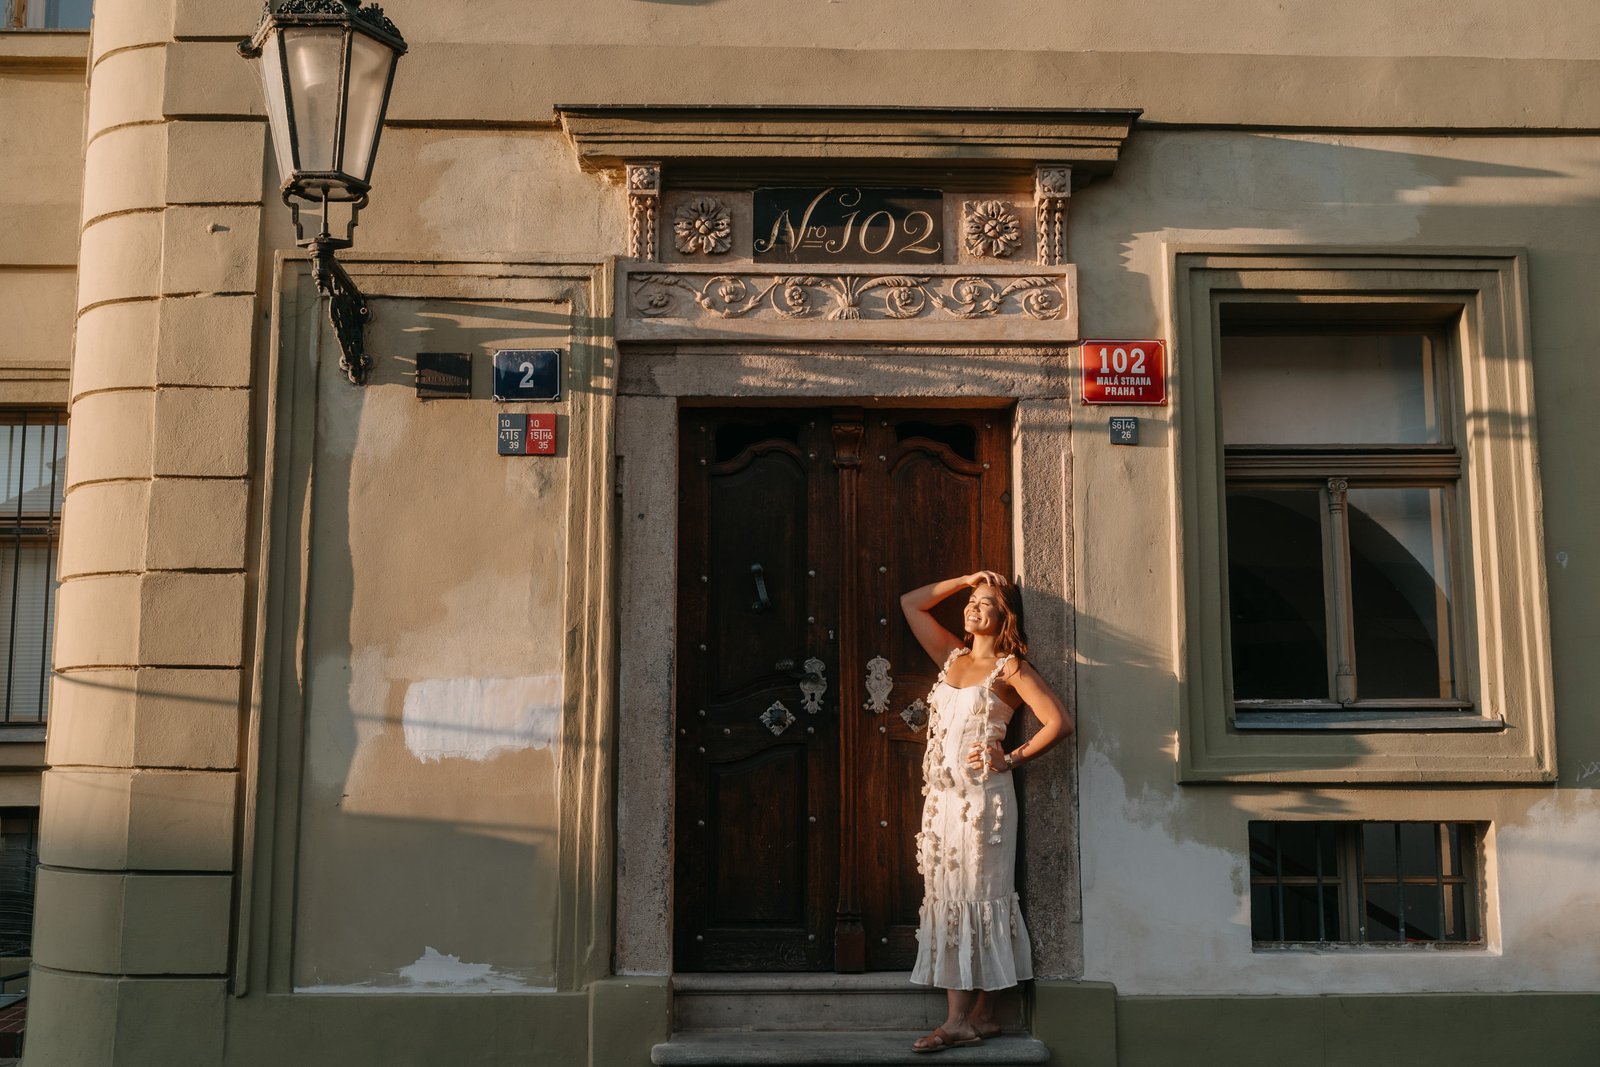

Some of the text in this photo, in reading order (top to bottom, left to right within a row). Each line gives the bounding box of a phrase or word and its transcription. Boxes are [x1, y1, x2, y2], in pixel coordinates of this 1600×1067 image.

[825, 188, 941, 254] 102
[1100, 347, 1146, 374] 102
[518, 361, 534, 388] 2
[1096, 375, 1152, 386] MALÁ STRANA
[1105, 386, 1143, 396] PRAHA 1
[501, 419, 511, 428] 10
[530, 419, 540, 428] 10
[1121, 430, 1132, 439] 26
[509, 441, 520, 450] 39
[538, 441, 549, 450] 35
